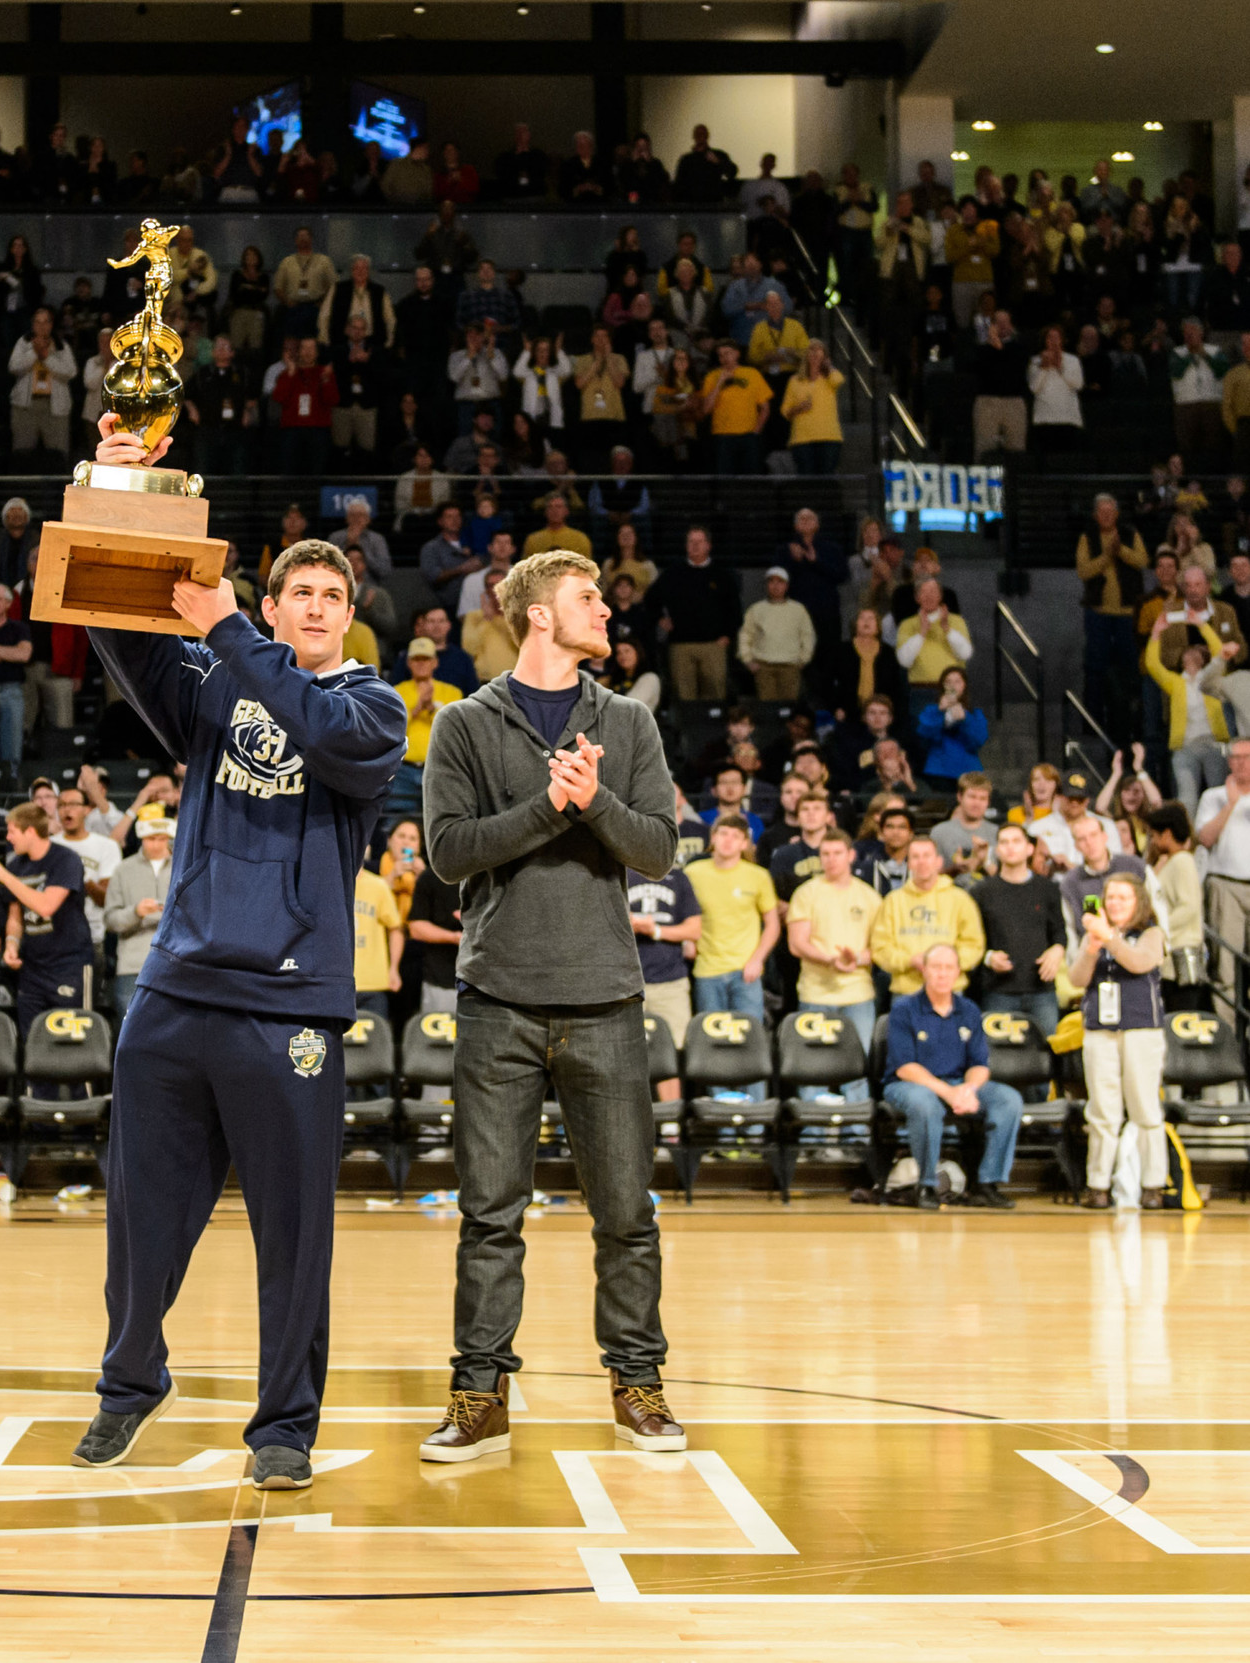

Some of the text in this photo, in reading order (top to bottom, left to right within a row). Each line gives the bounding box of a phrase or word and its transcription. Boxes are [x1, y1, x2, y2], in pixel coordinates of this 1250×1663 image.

[252, 728, 288, 765] 37
[45, 1009, 94, 1042] GT
[702, 1011, 751, 1044] GT
[794, 1012, 844, 1045] GT
[981, 1012, 1030, 1044] GT
[1170, 1012, 1220, 1045] GT
